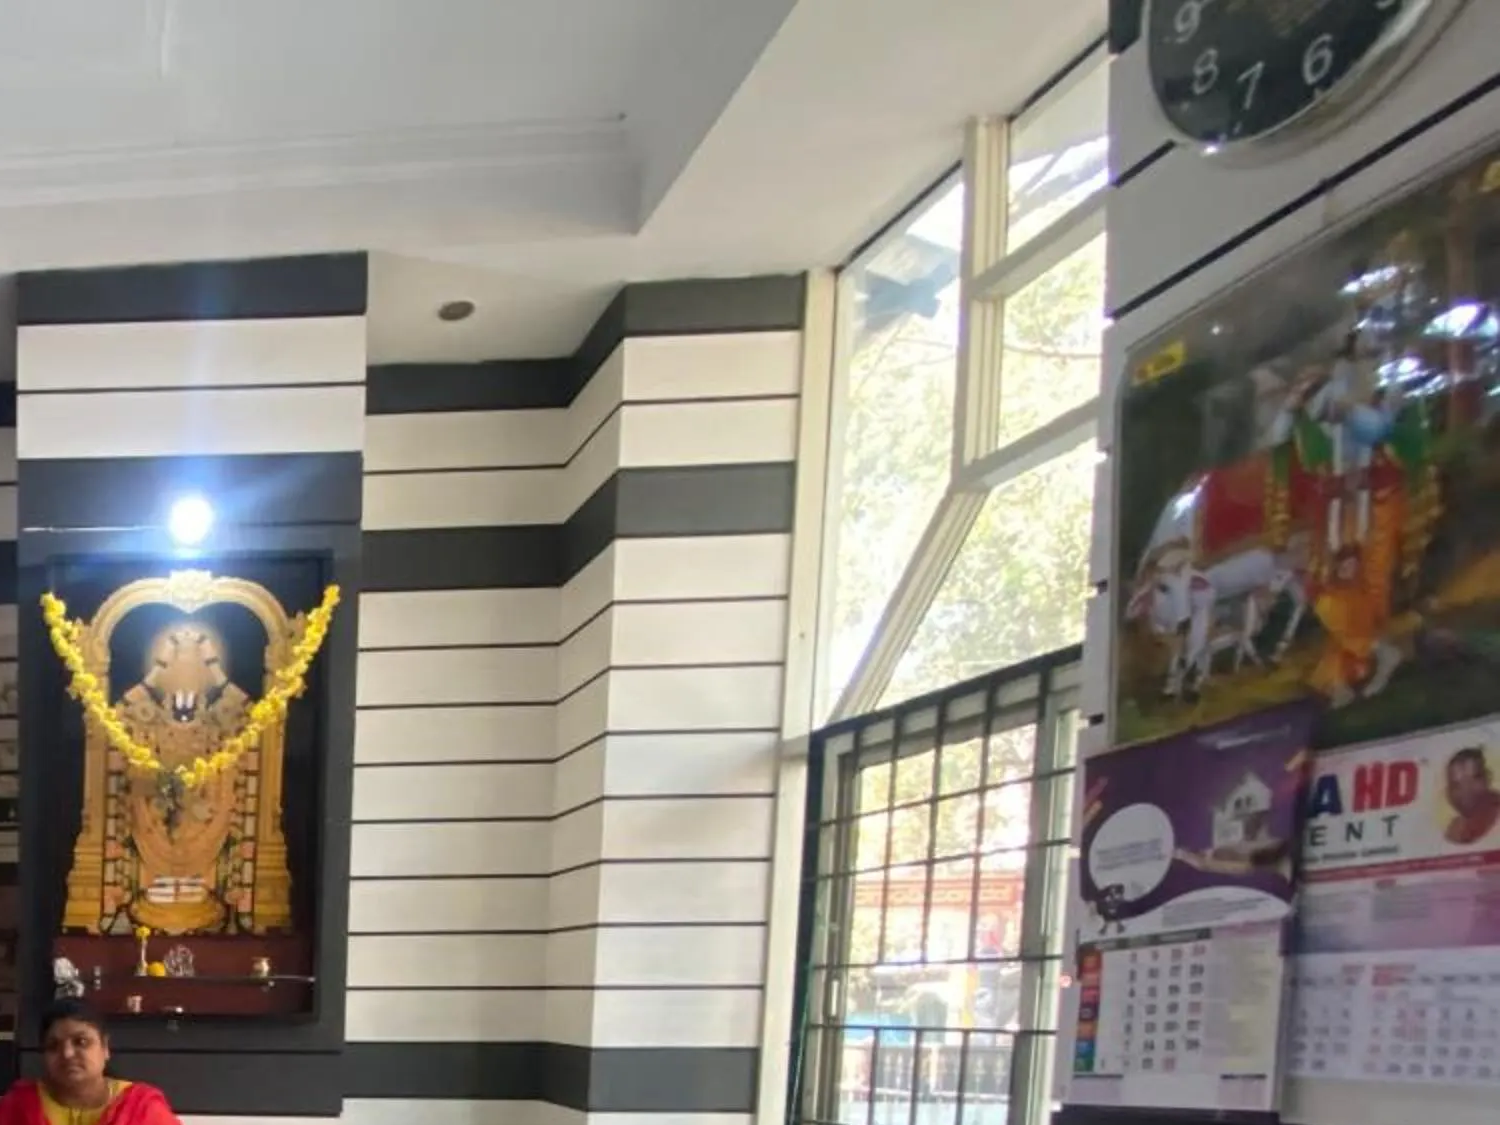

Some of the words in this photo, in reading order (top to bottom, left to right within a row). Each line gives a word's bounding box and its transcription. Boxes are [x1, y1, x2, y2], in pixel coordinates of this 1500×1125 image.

[1173, 0, 1200, 44] 9
[1192, 48, 1219, 95] 8
[1303, 33, 1334, 85] 6
[1236, 60, 1265, 110] 7
[1351, 760, 1419, 813] HD
